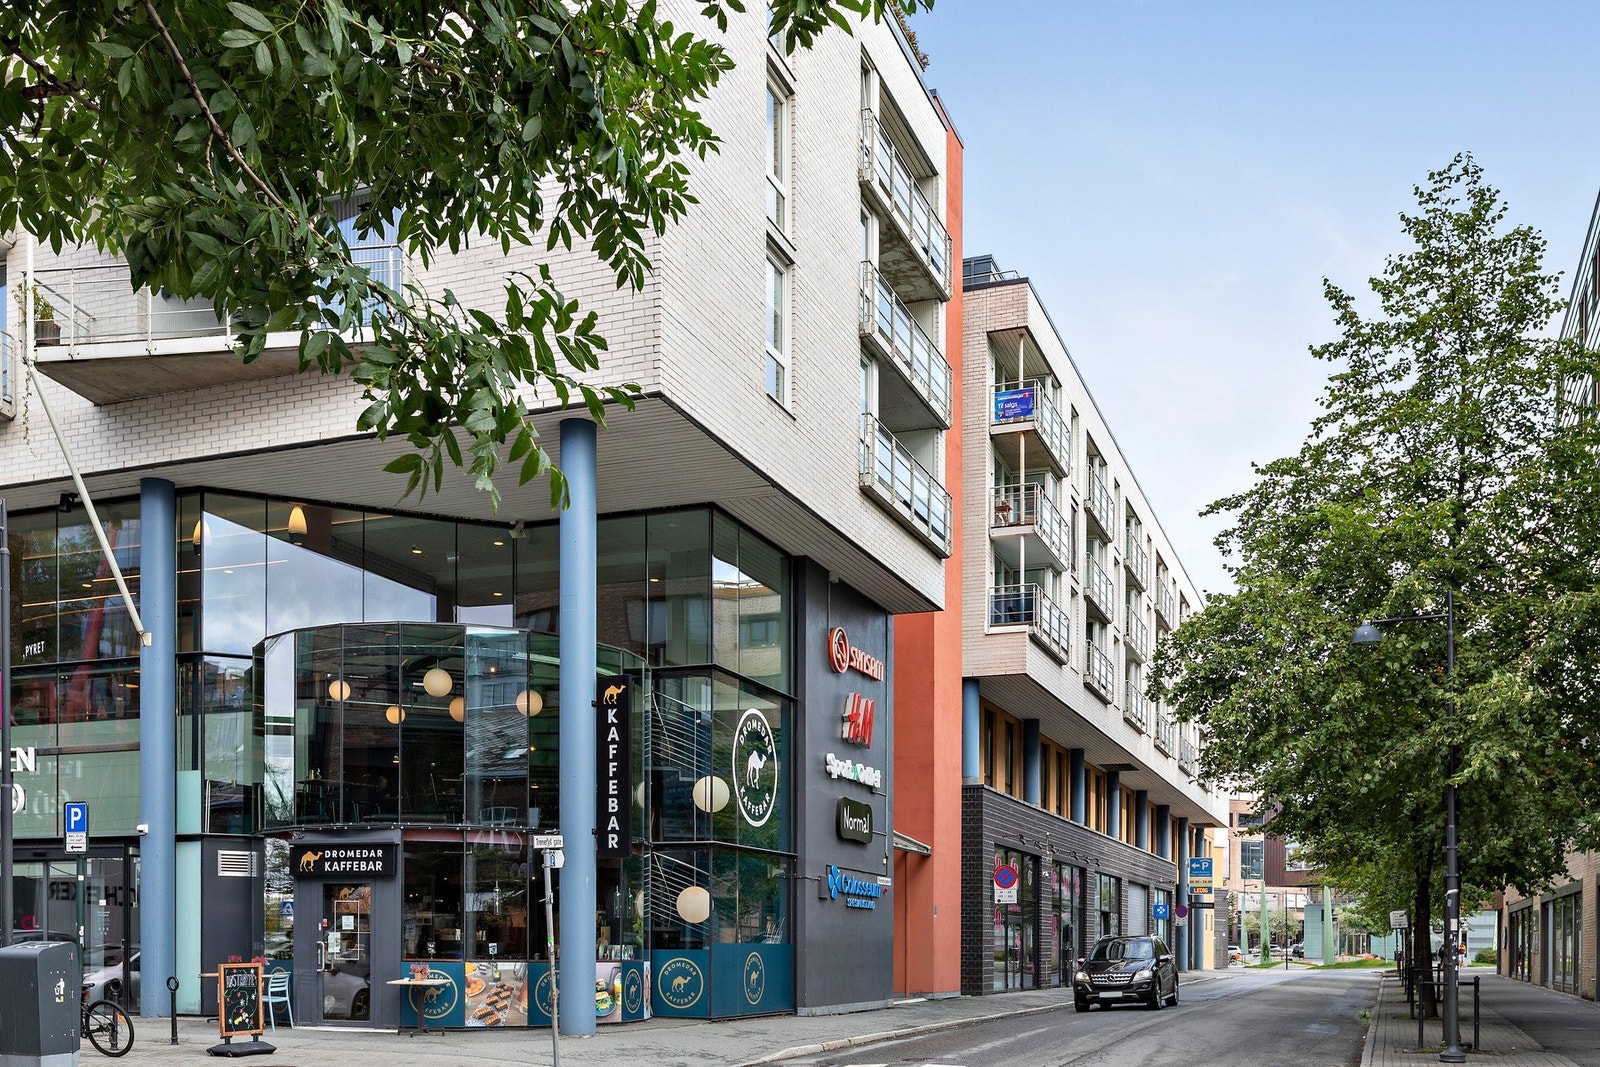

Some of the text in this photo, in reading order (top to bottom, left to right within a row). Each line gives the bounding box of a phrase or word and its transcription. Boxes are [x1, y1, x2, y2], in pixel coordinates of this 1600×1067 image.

[842, 692, 875, 750] H&M
[739, 719, 773, 756] DROMEDAR
[606, 708, 620, 849] KAFFEBAR
[740, 785, 771, 816] KAFFEBAR
[71, 807, 82, 830] P
[843, 805, 870, 834] Normal
[324, 849, 383, 858] DROMEDAR
[324, 861, 383, 872] KAFFEBAR
[842, 873, 881, 898] Colosseum
[664, 962, 697, 976] DROMEDAR
[665, 992, 696, 1004] KAFFEBAR
